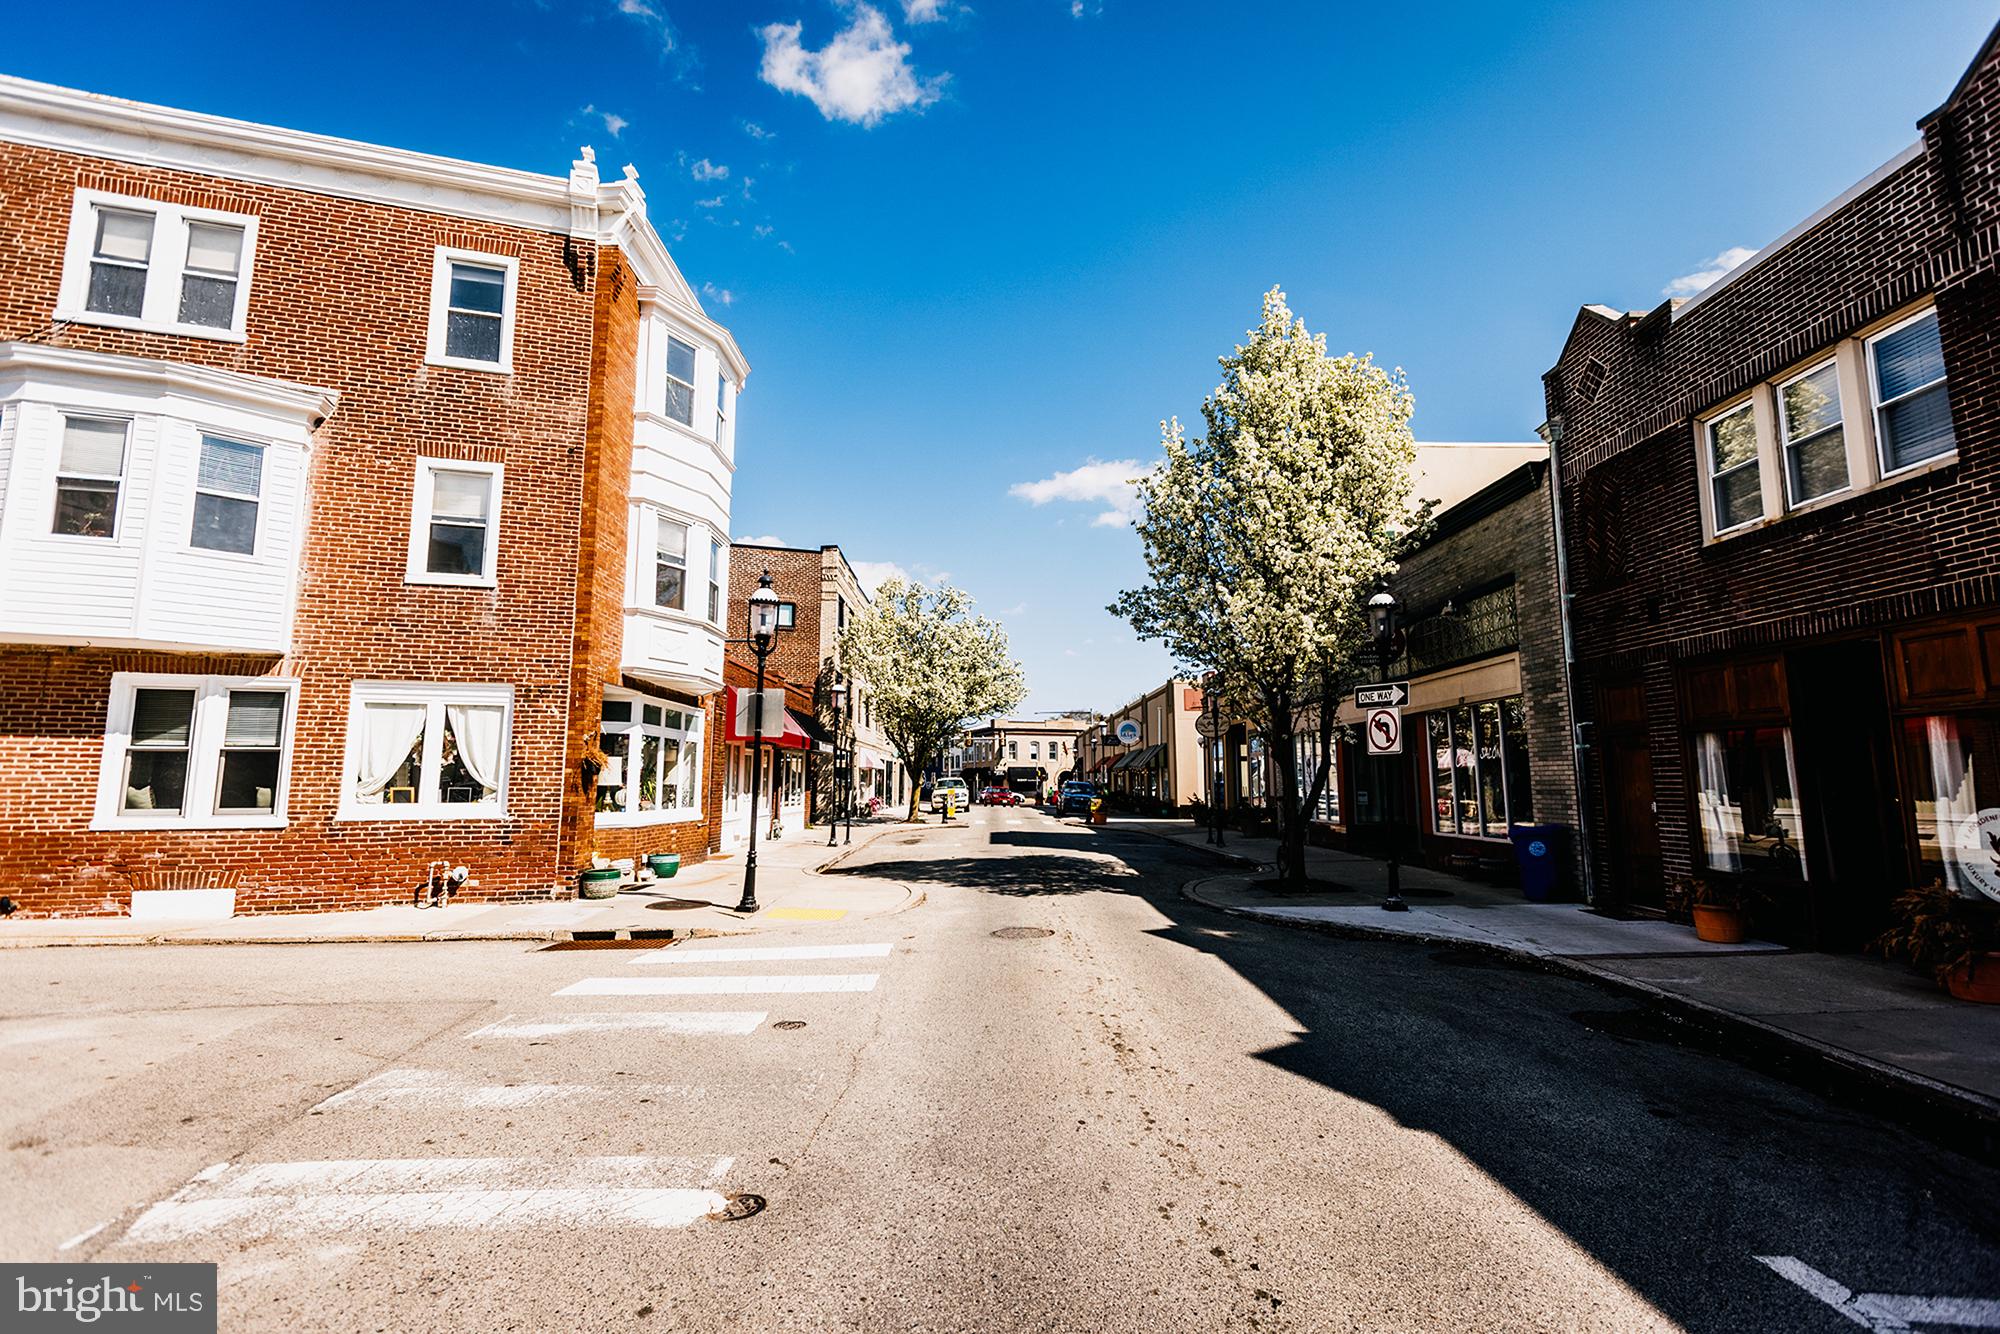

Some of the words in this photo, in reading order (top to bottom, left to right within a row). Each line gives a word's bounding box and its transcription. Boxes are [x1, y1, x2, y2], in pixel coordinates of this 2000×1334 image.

[1360, 692, 1375, 702] ONE
[1377, 691, 1393, 700] WAY
[1965, 862, 1989, 887] LUXURY
